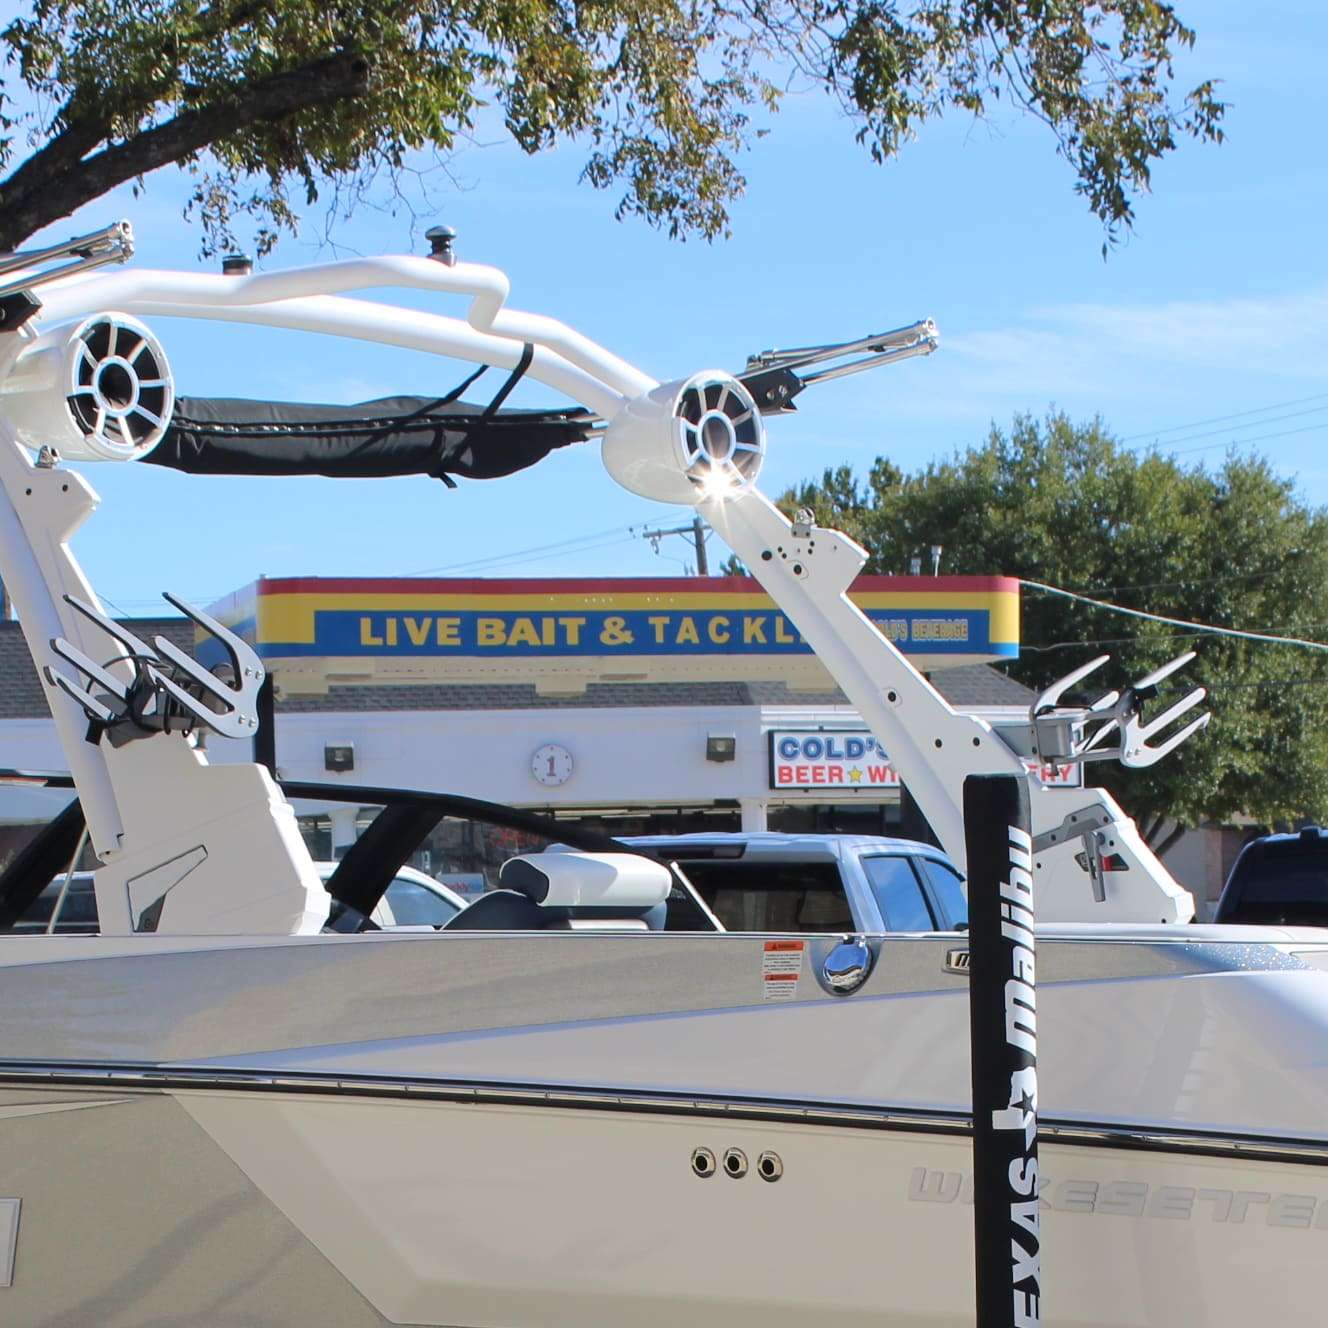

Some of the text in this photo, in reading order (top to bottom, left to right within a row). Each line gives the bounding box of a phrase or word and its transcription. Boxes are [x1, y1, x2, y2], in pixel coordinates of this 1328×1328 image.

[360, 616, 809, 645] LIVE BAIT & TACKL
[778, 765, 843, 783] BEER
[999, 824, 1036, 1057] Malibu
